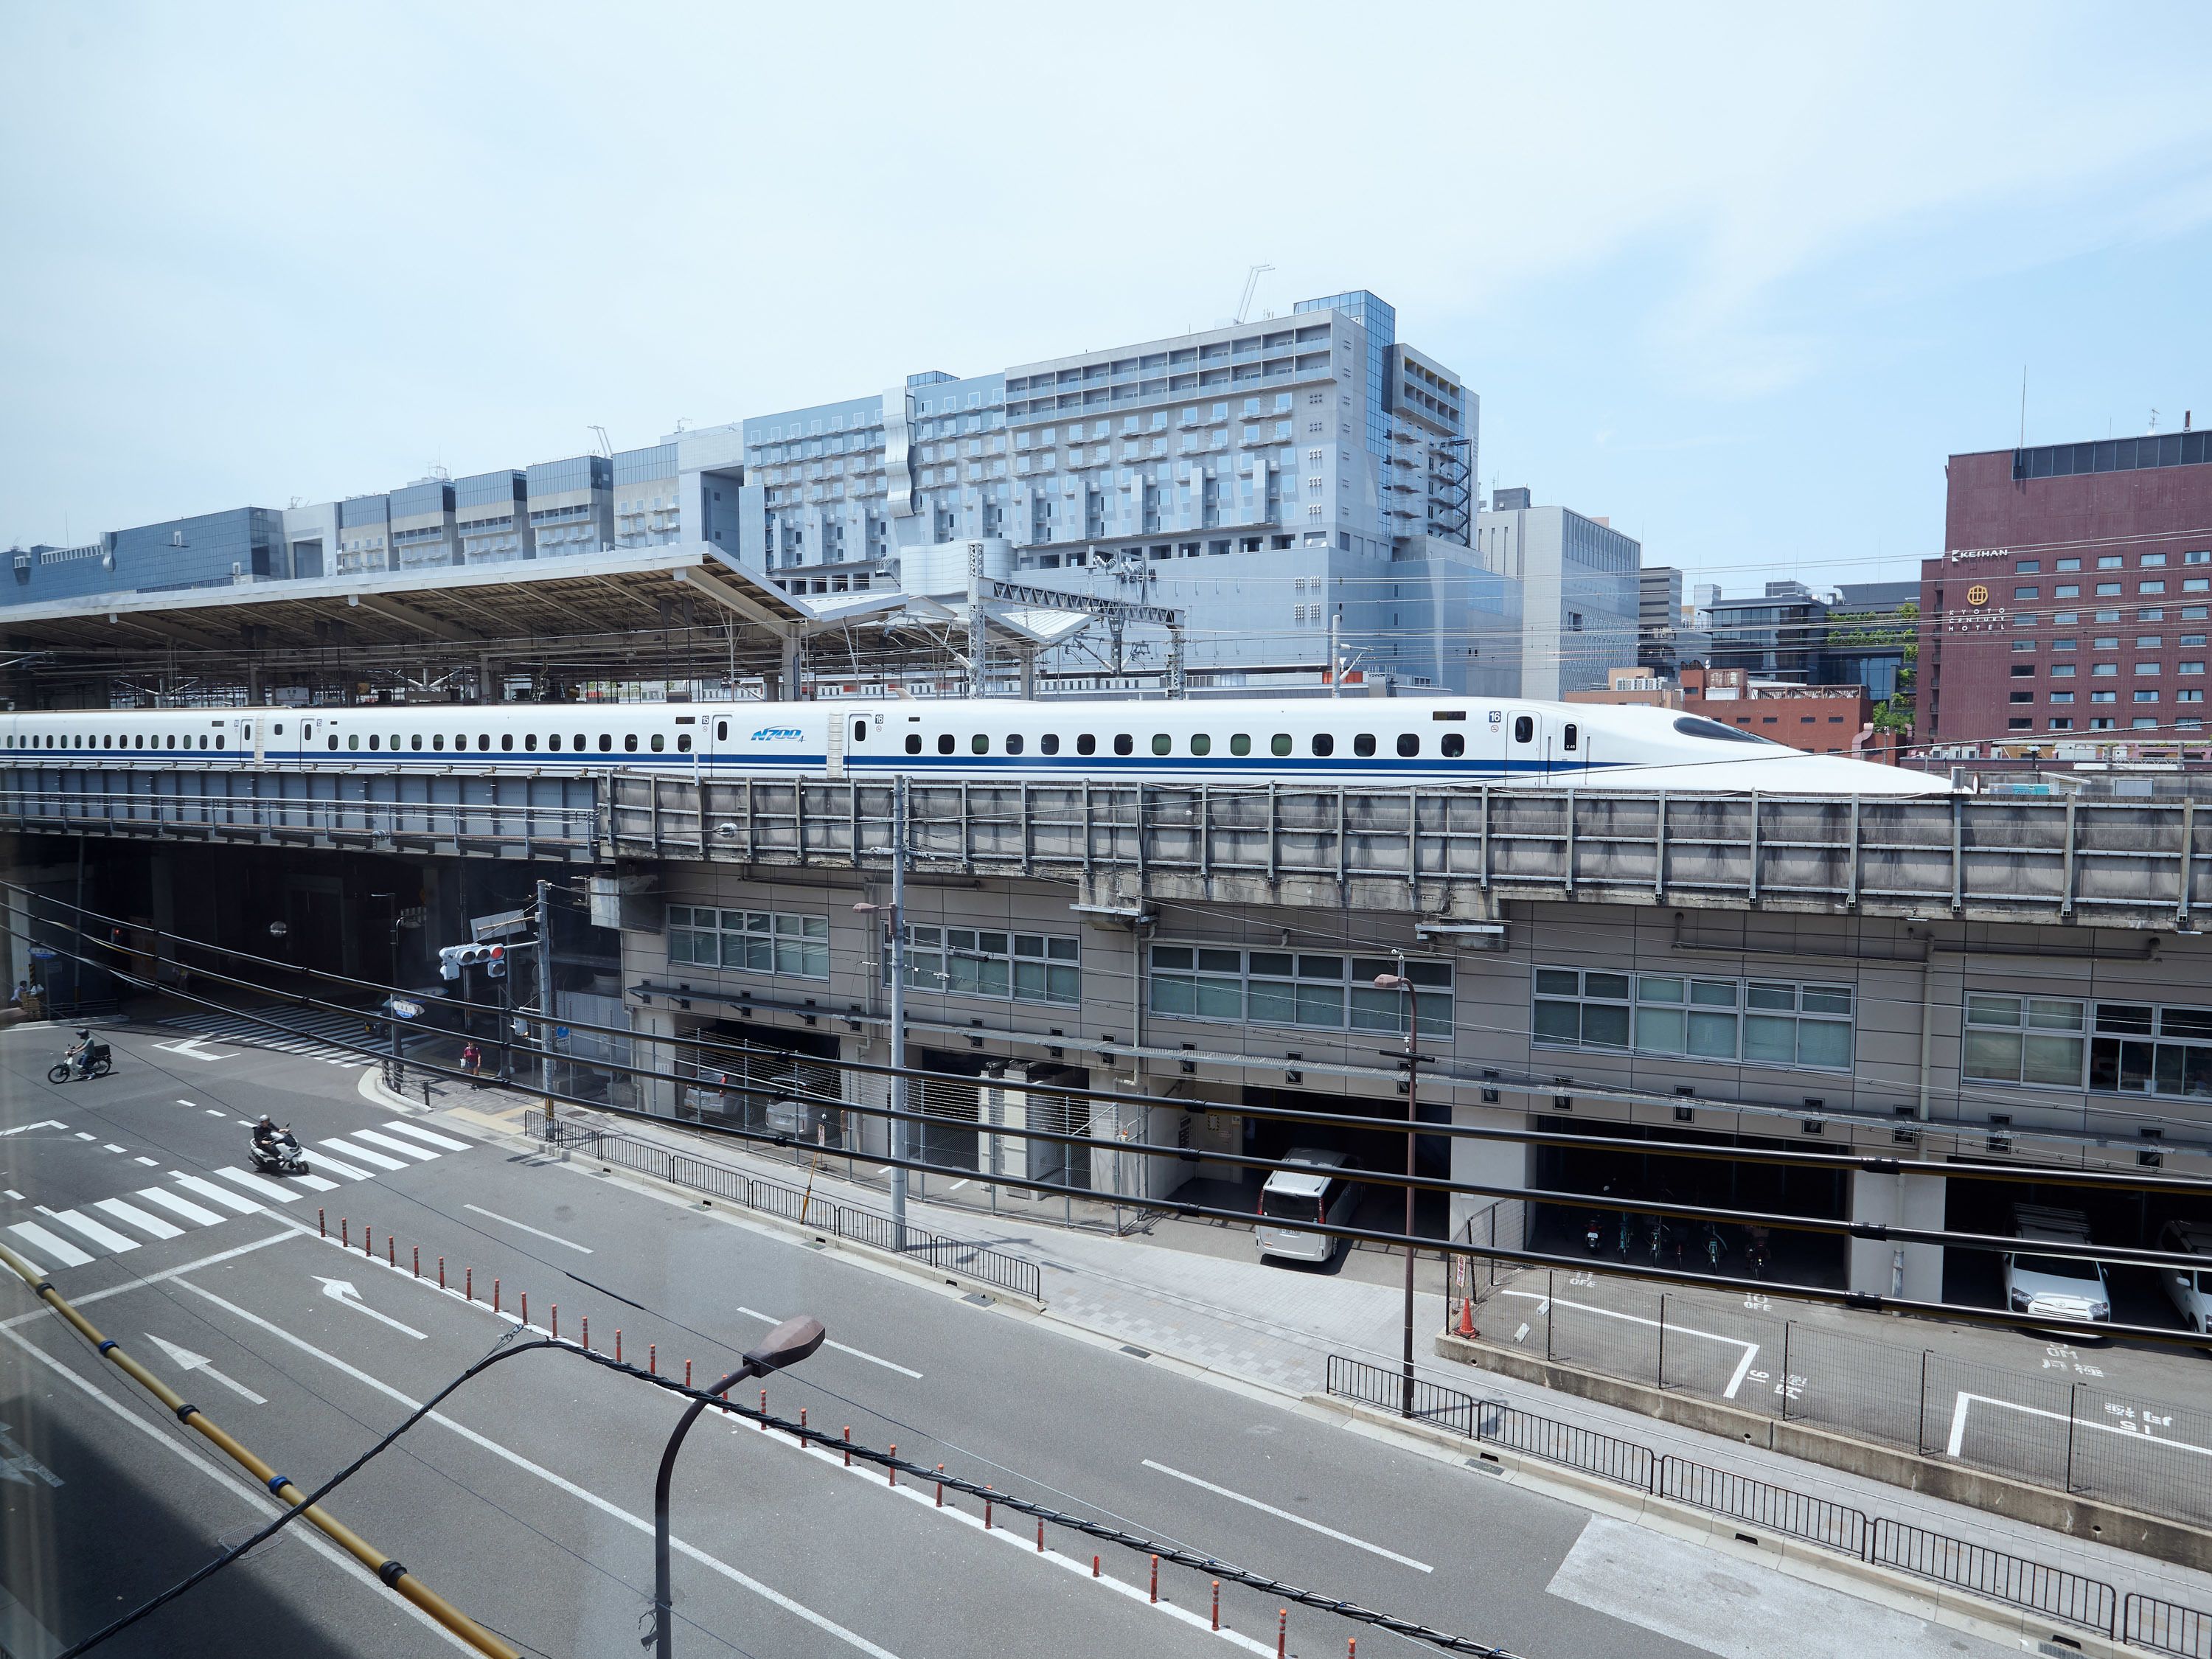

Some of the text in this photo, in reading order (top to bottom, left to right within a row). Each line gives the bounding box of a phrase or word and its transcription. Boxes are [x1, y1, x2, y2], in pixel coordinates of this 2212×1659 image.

[1961, 549, 2008, 558] KEIHAN
[1949, 608, 2005, 616] KYOTO
[1948, 624, 2005, 632] HOTEL
[702, 716, 709, 724] 15
[875, 715, 883, 724] 16
[1489, 712, 1500, 722] 16
[1747, 1369, 1770, 1383] 16
[2120, 1420, 2151, 1435] 15
